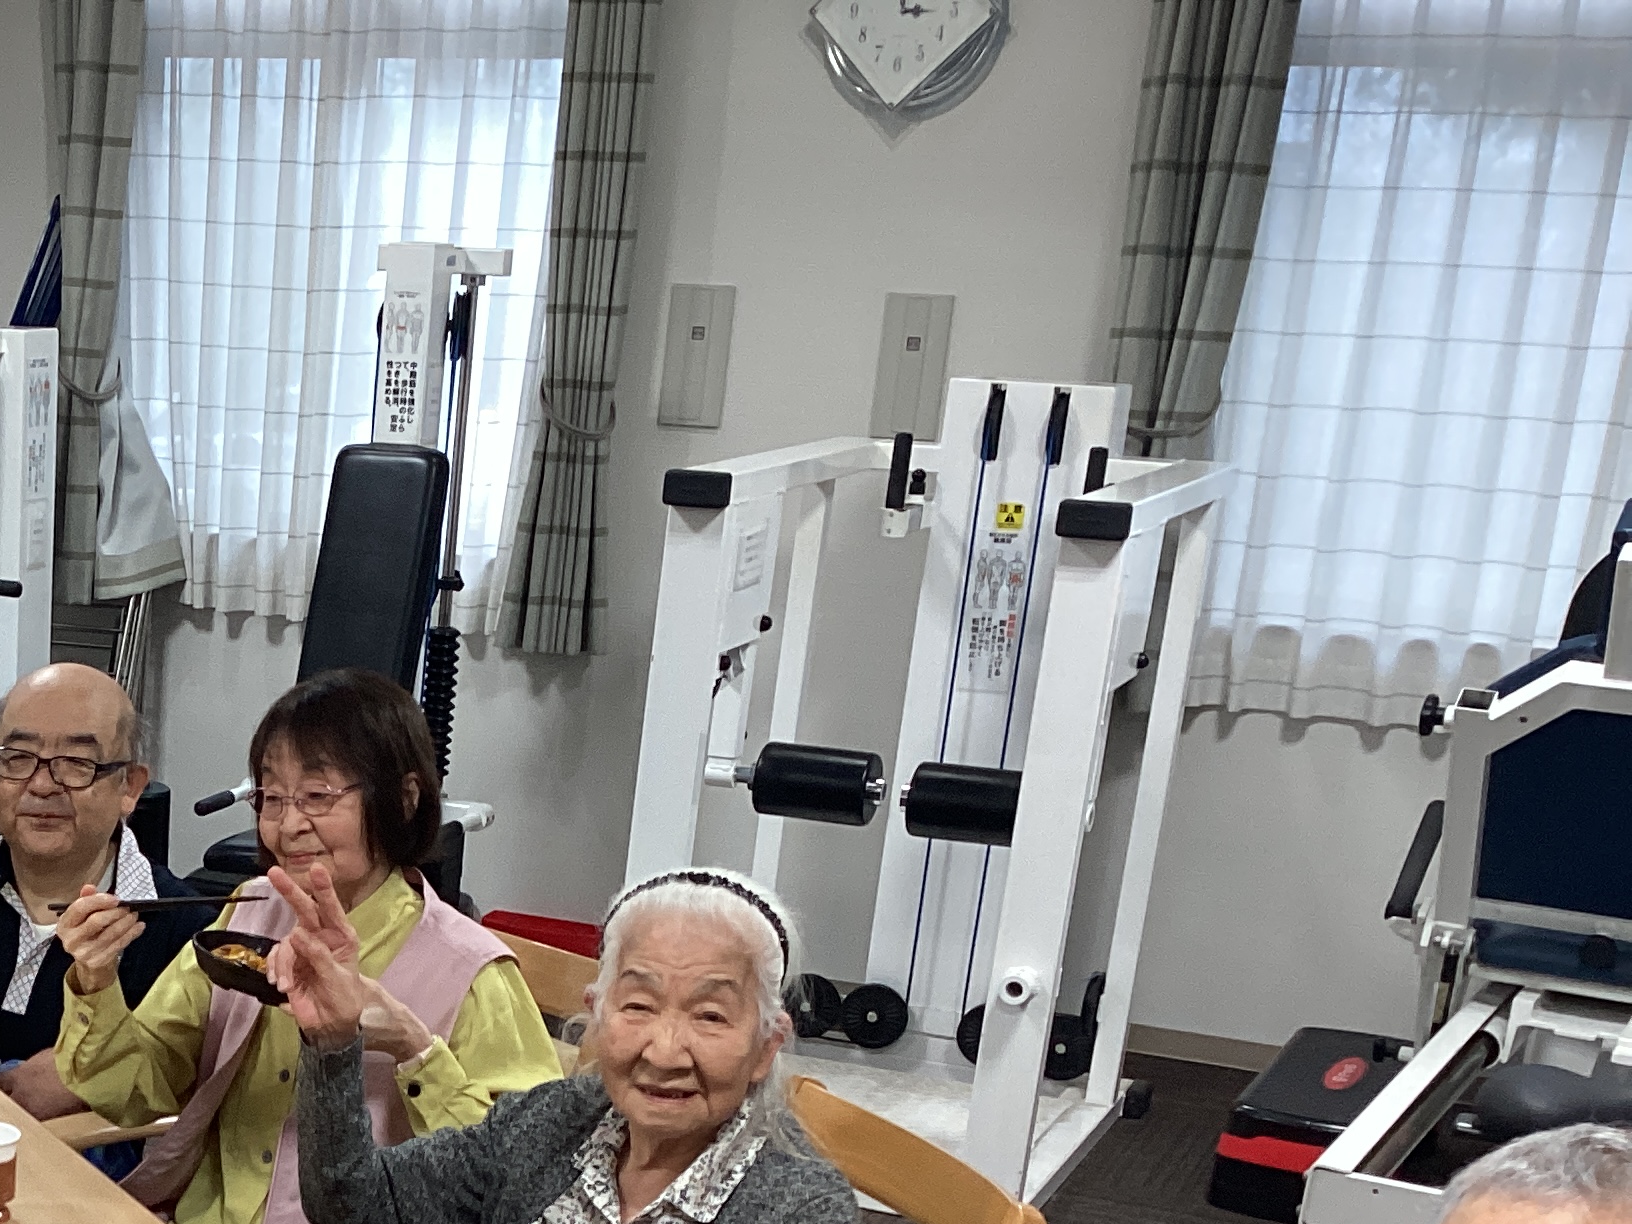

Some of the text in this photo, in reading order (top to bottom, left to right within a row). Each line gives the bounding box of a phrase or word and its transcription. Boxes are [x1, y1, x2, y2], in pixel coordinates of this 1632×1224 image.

[849, 2, 860, 20] 9
[858, 26, 868, 44] 8
[935, 23, 945, 42] 4
[873, 44, 885, 63] 7
[892, 55, 903, 73] 6
